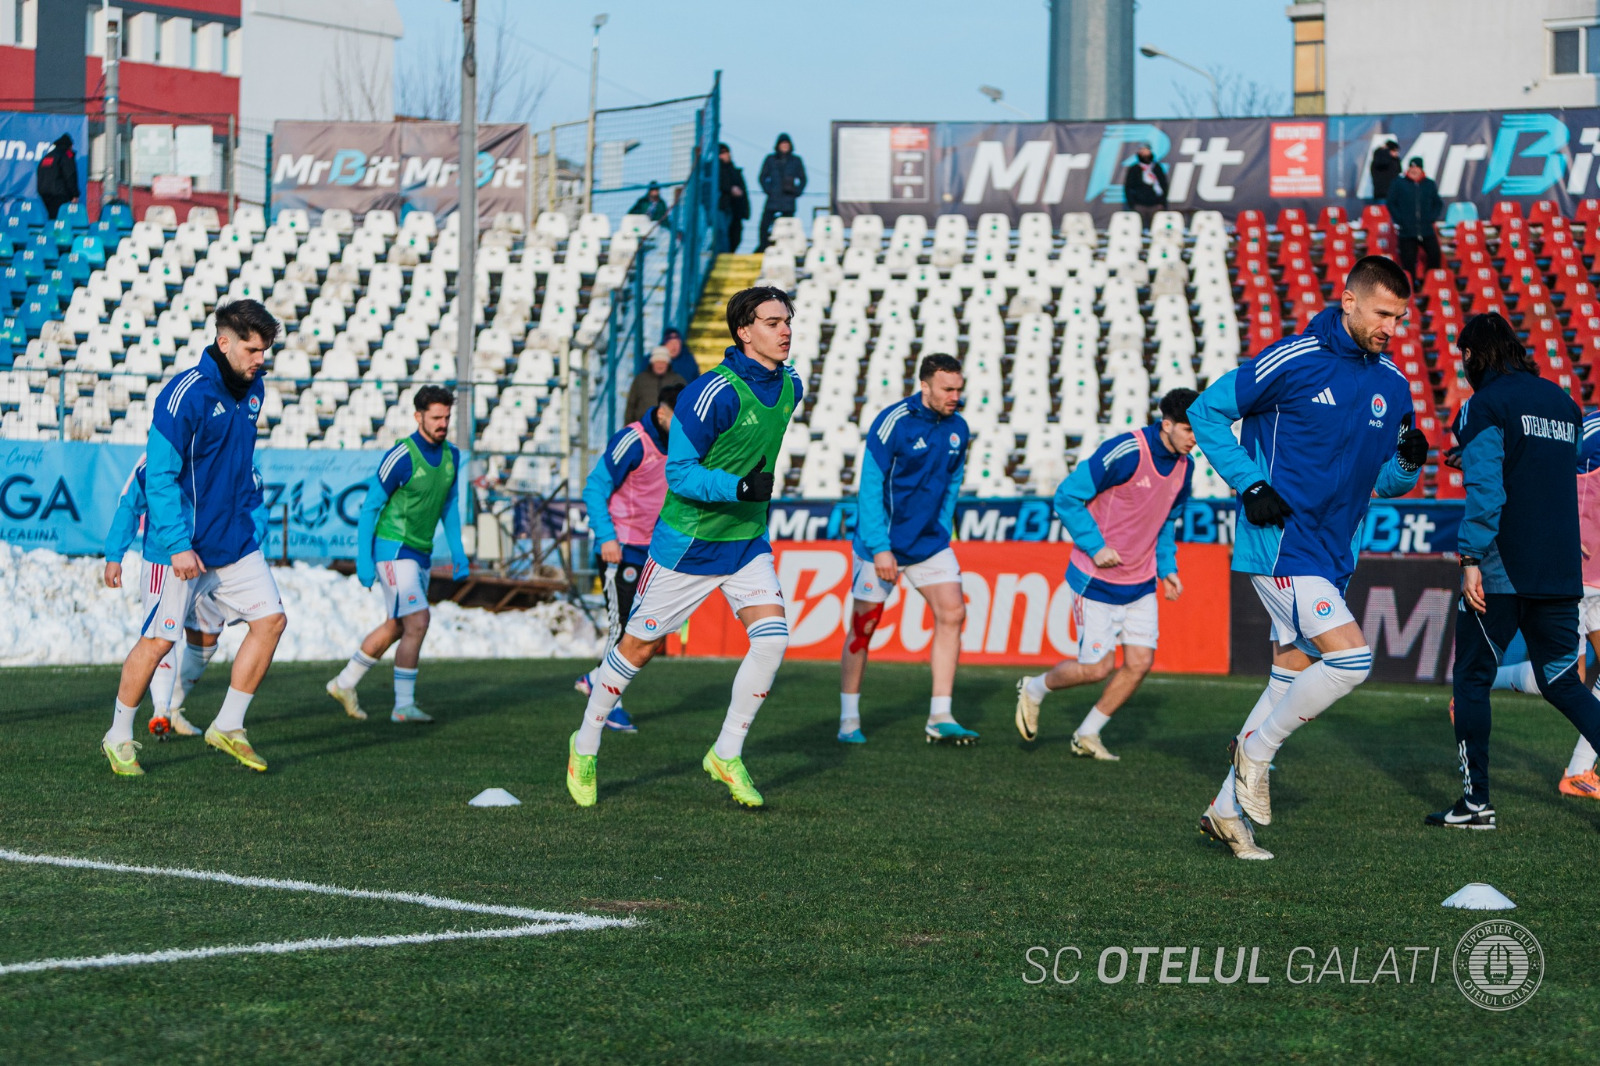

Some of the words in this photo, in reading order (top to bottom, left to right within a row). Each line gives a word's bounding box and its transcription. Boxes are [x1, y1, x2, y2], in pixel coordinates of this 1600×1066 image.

[273, 149, 399, 187] MrBit
[962, 123, 1244, 204] MrBit
[1356, 113, 1600, 199] MrBi
[1361, 586, 1455, 683] M
